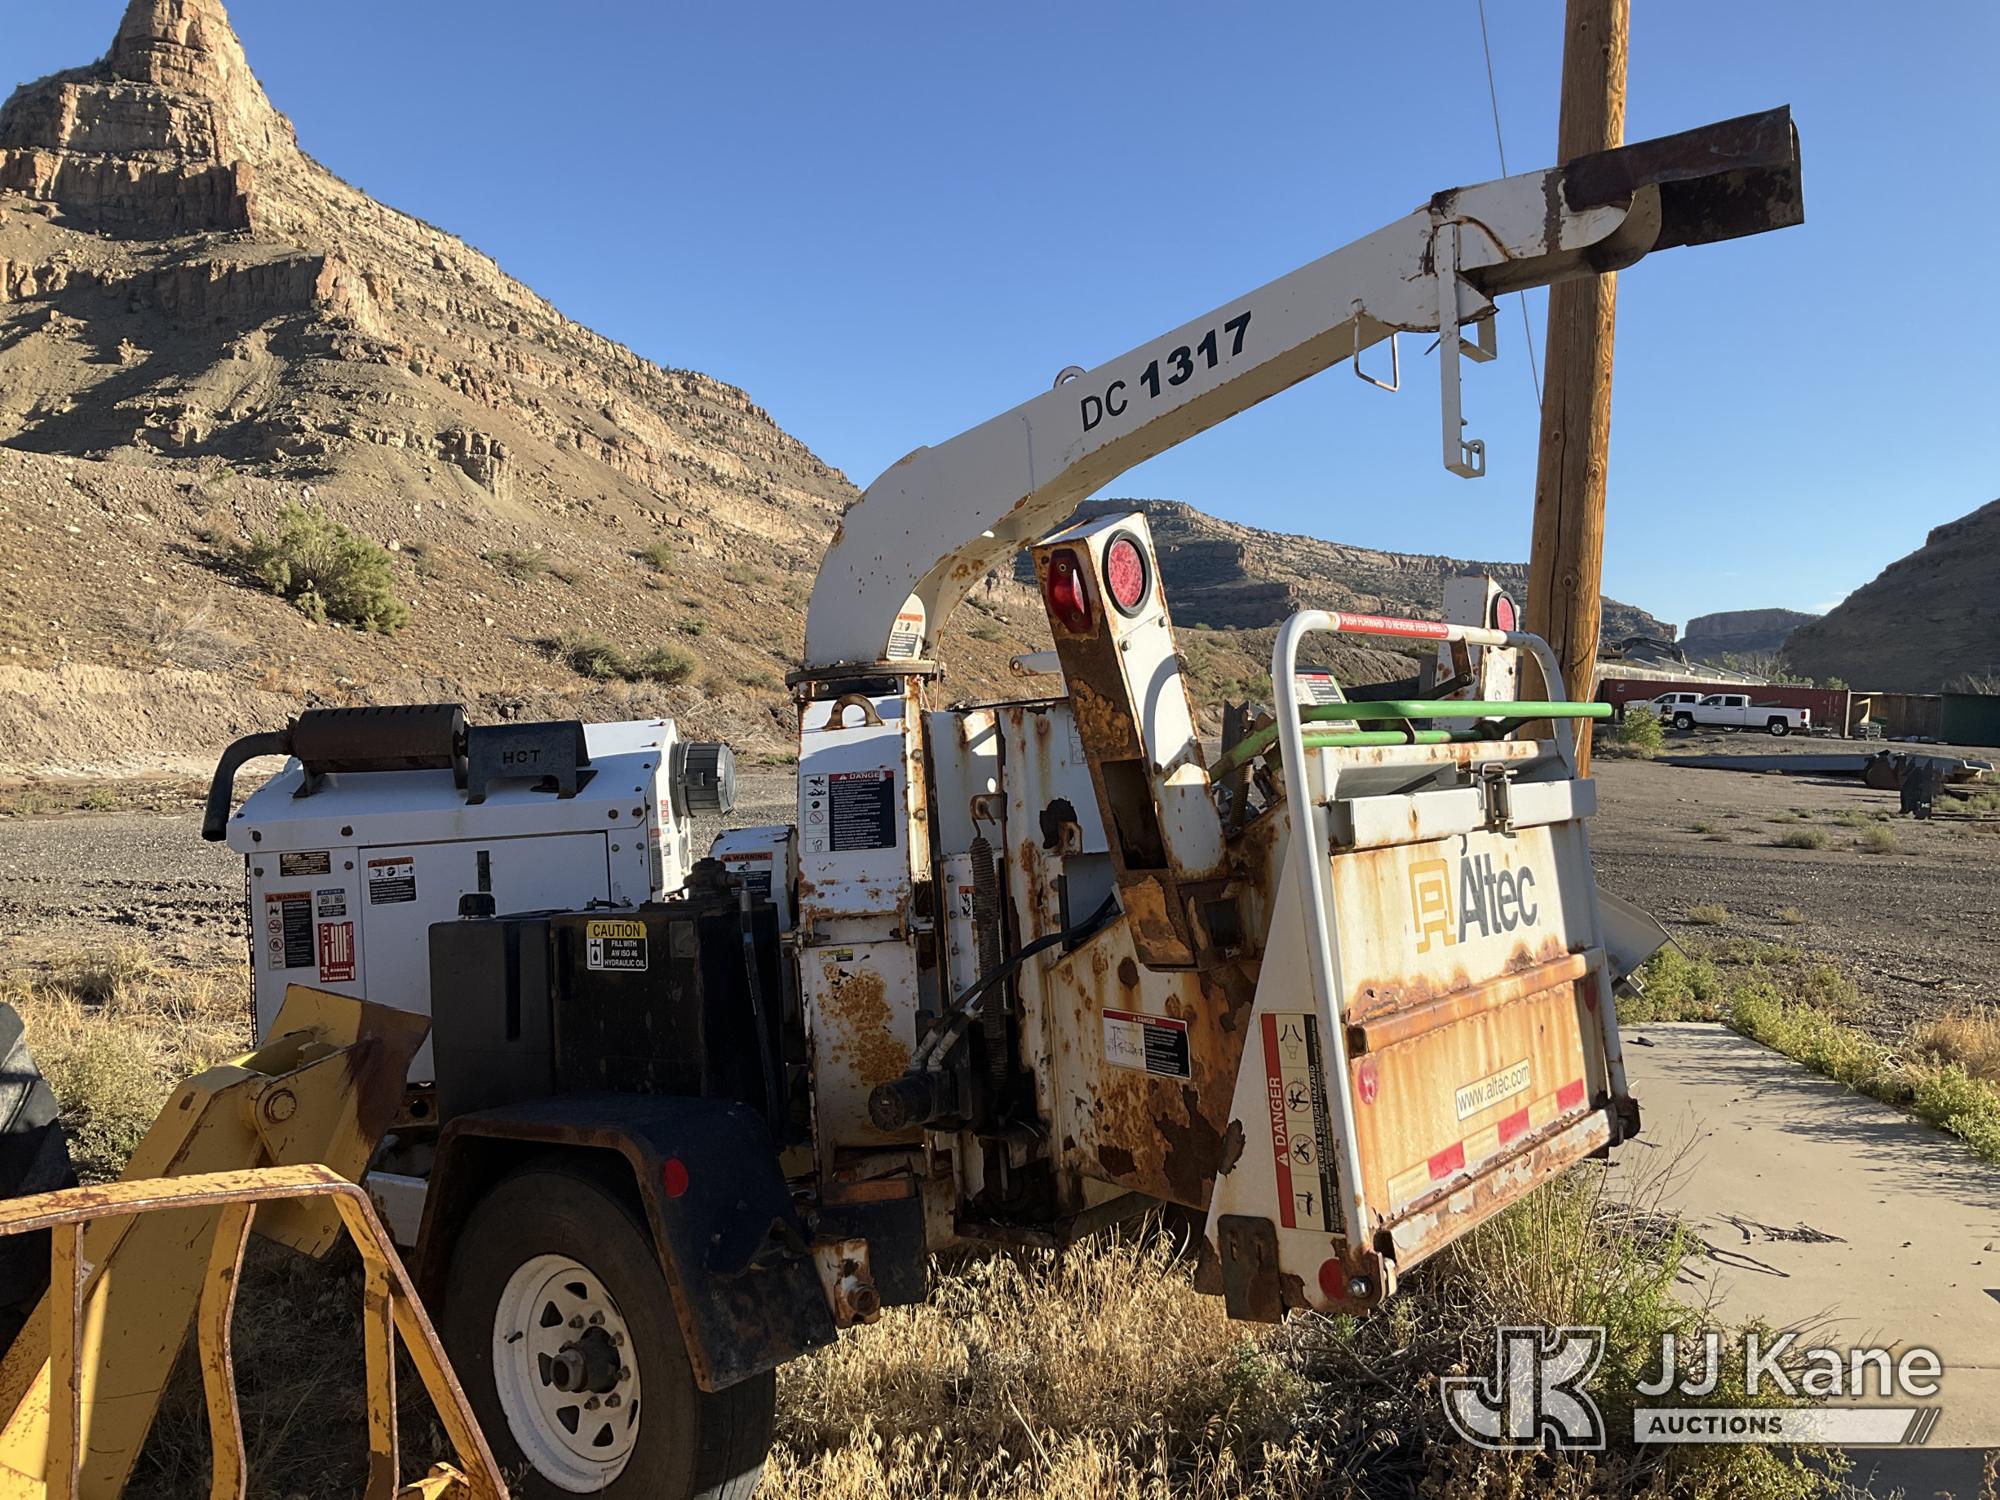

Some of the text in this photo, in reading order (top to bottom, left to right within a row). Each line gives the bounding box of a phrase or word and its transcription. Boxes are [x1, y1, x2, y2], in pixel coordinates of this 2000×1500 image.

[1080, 310, 1251, 432] DC 1317
[1341, 614, 1357, 626] PUSH
[1357, 616, 1385, 629] FORWARD
[503, 750, 540, 765] HOT
[849, 772, 884, 780] DANGE
[1458, 853, 1538, 943] Altec
[593, 924, 640, 937] CAUTION
[611, 940, 637, 948] FILL WITH
[621, 949, 630, 957] ISO
[604, 959, 635, 967] HYDRAULIC
[1309, 1065, 1318, 1102] HAZARD
[1457, 1065, 1529, 1113] www.altec.com
[1269, 1076, 1287, 1147] DANGER
[1313, 1104, 1322, 1134] CRUSH
[1317, 1145, 1326, 1174] SEVER
